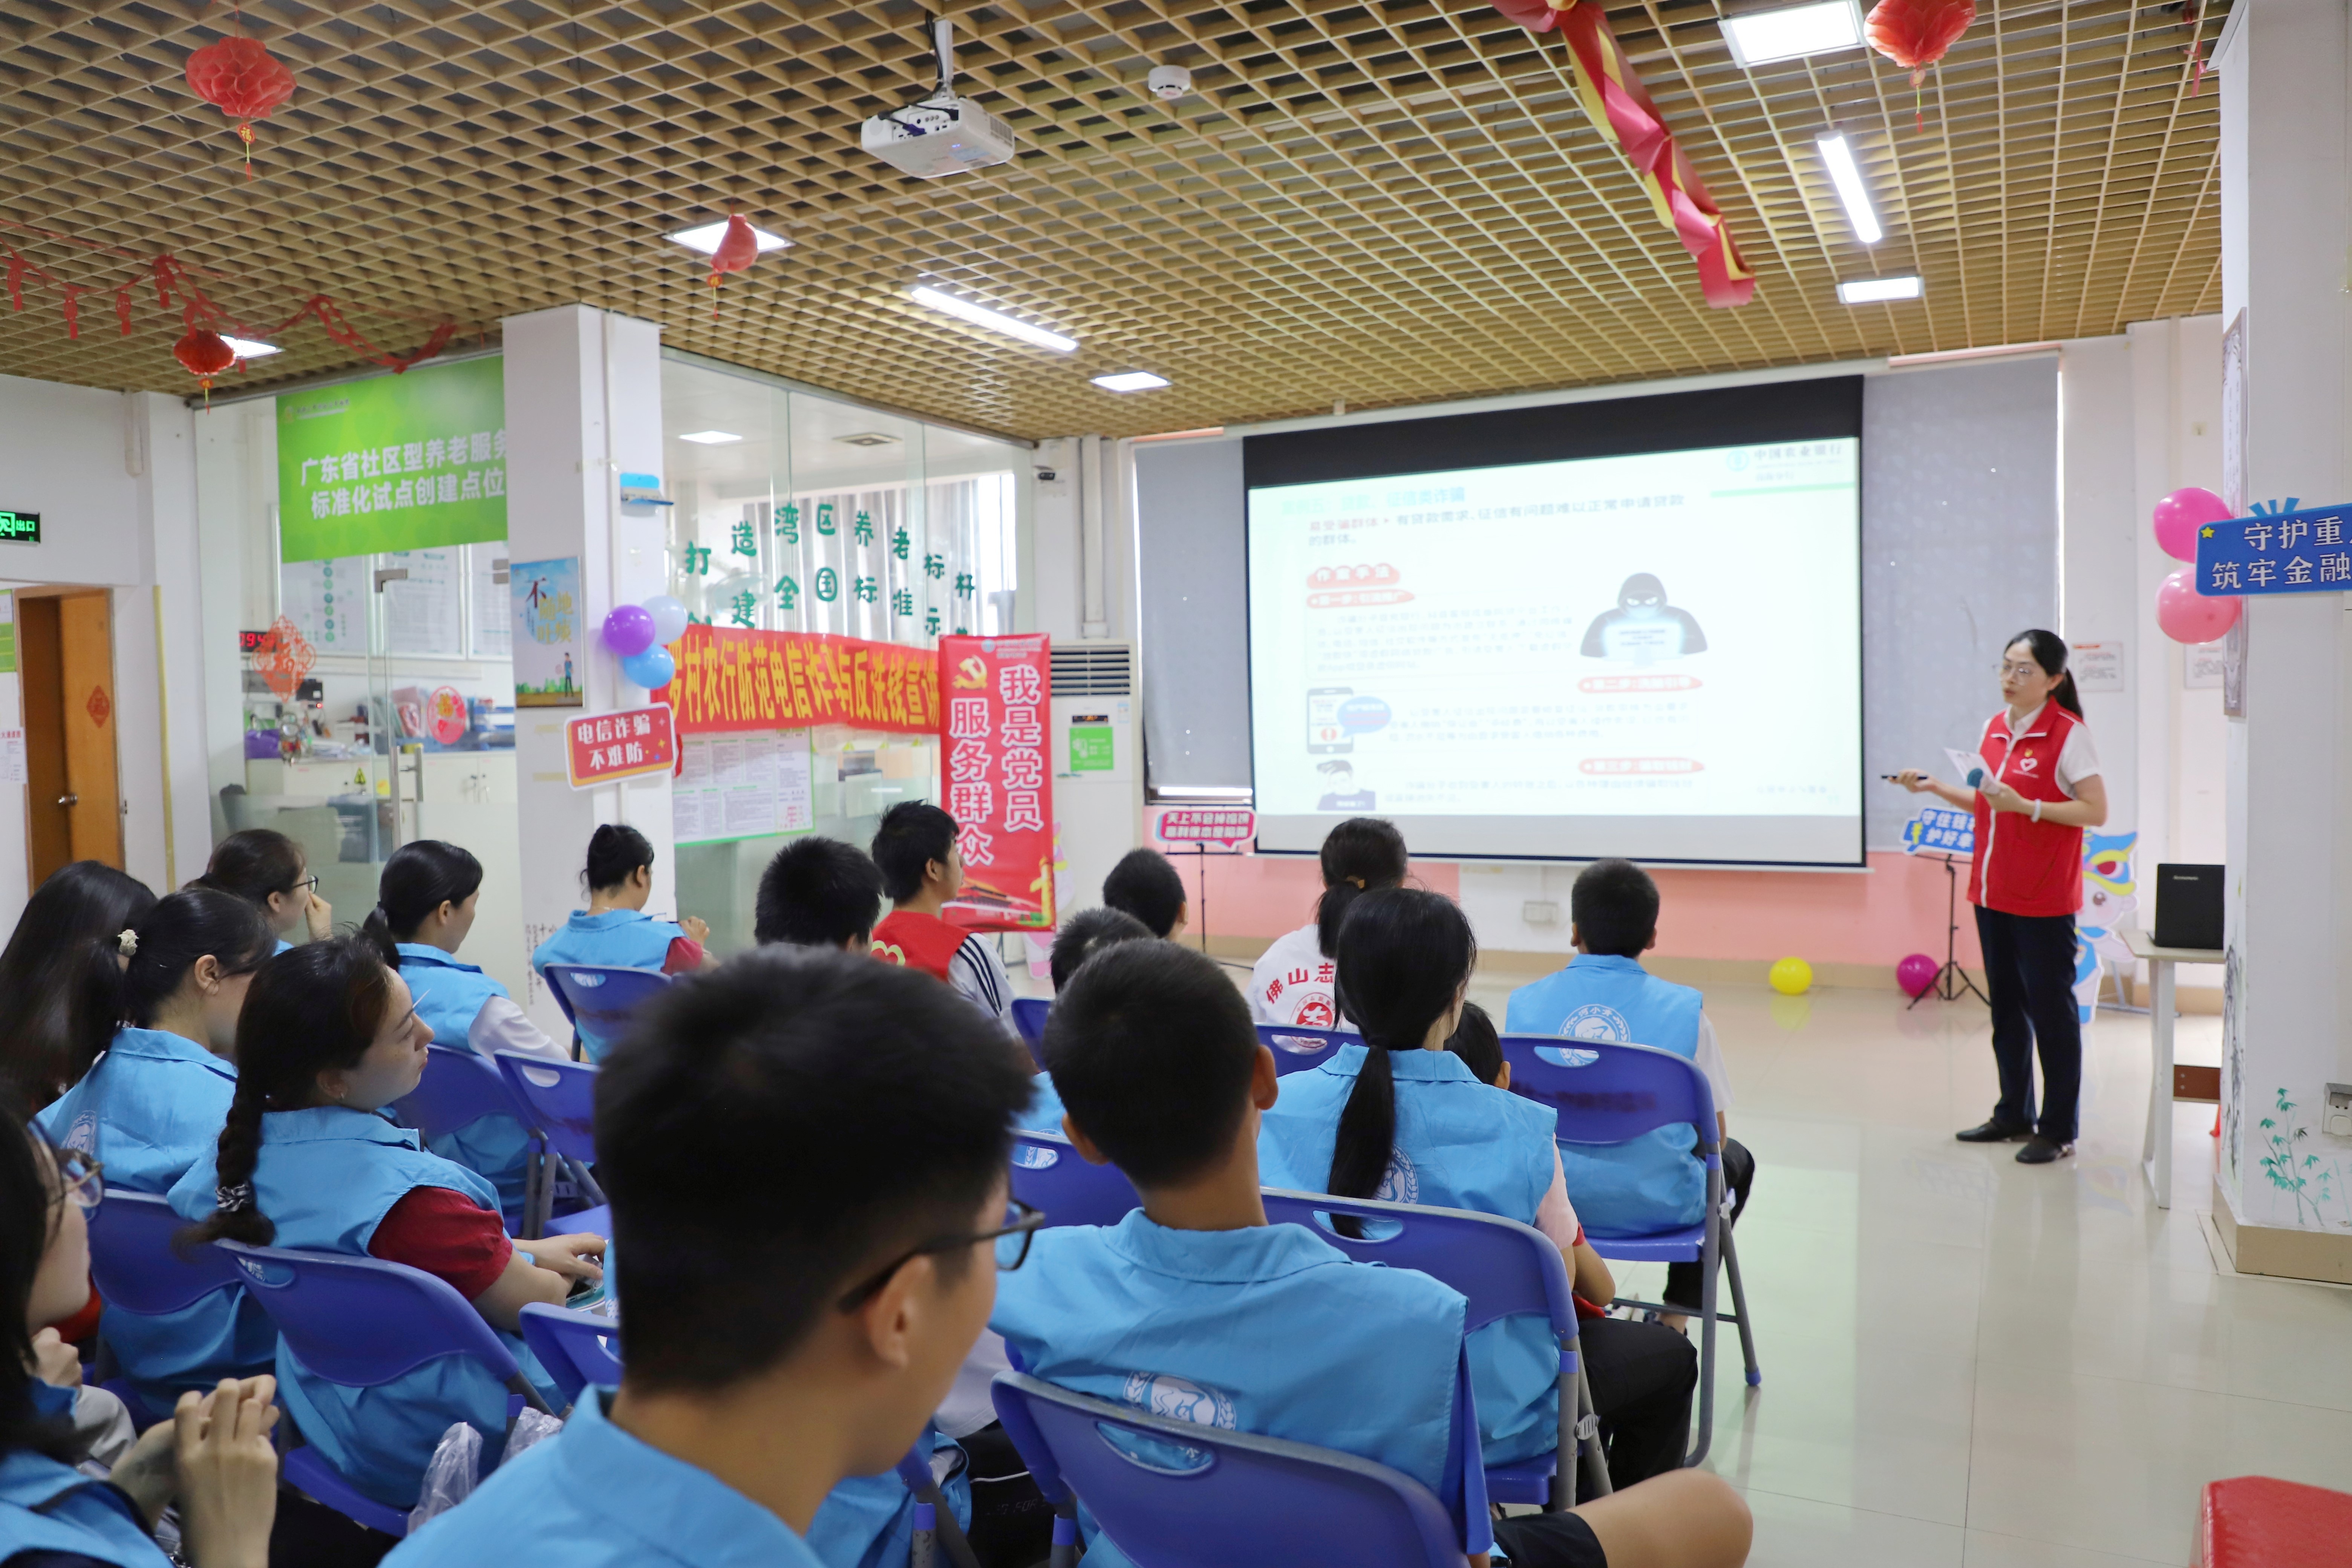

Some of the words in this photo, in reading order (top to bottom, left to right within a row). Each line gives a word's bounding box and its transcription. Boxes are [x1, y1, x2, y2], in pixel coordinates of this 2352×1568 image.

[16, 520, 35, 532] 出口
[2243, 515, 2352, 551] 守护重
[2212, 551, 2352, 590] 筑牢金融
[688, 567, 968, 636] 建全国标准示
[577, 713, 651, 745] 电信诈骗
[588, 741, 643, 770] 不难防
[1000, 665, 1044, 833] 我是党员
[950, 698, 994, 867] 服务群众
